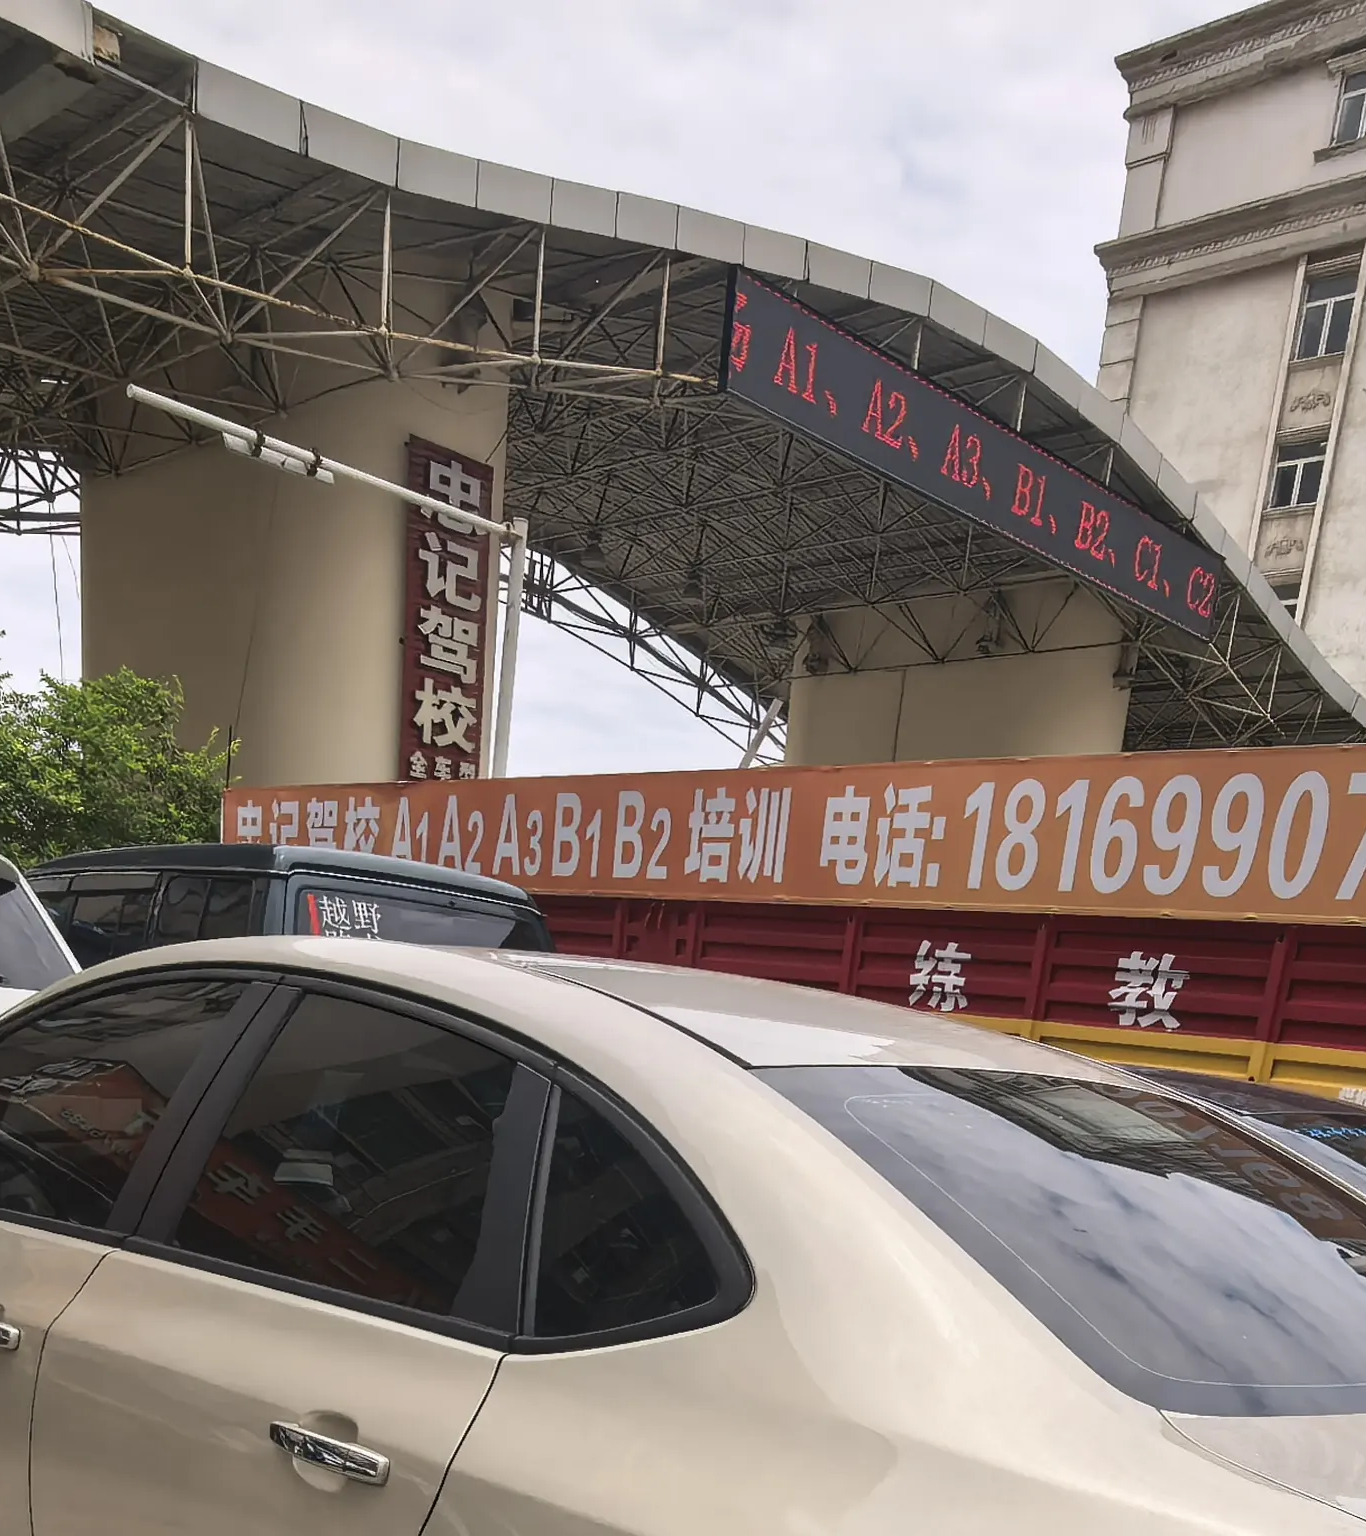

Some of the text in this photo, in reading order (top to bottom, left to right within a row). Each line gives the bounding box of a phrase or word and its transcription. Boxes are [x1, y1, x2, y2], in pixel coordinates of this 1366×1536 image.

[414, 460, 488, 753] 忠记驾校
[318, 895, 382, 934] 越野
